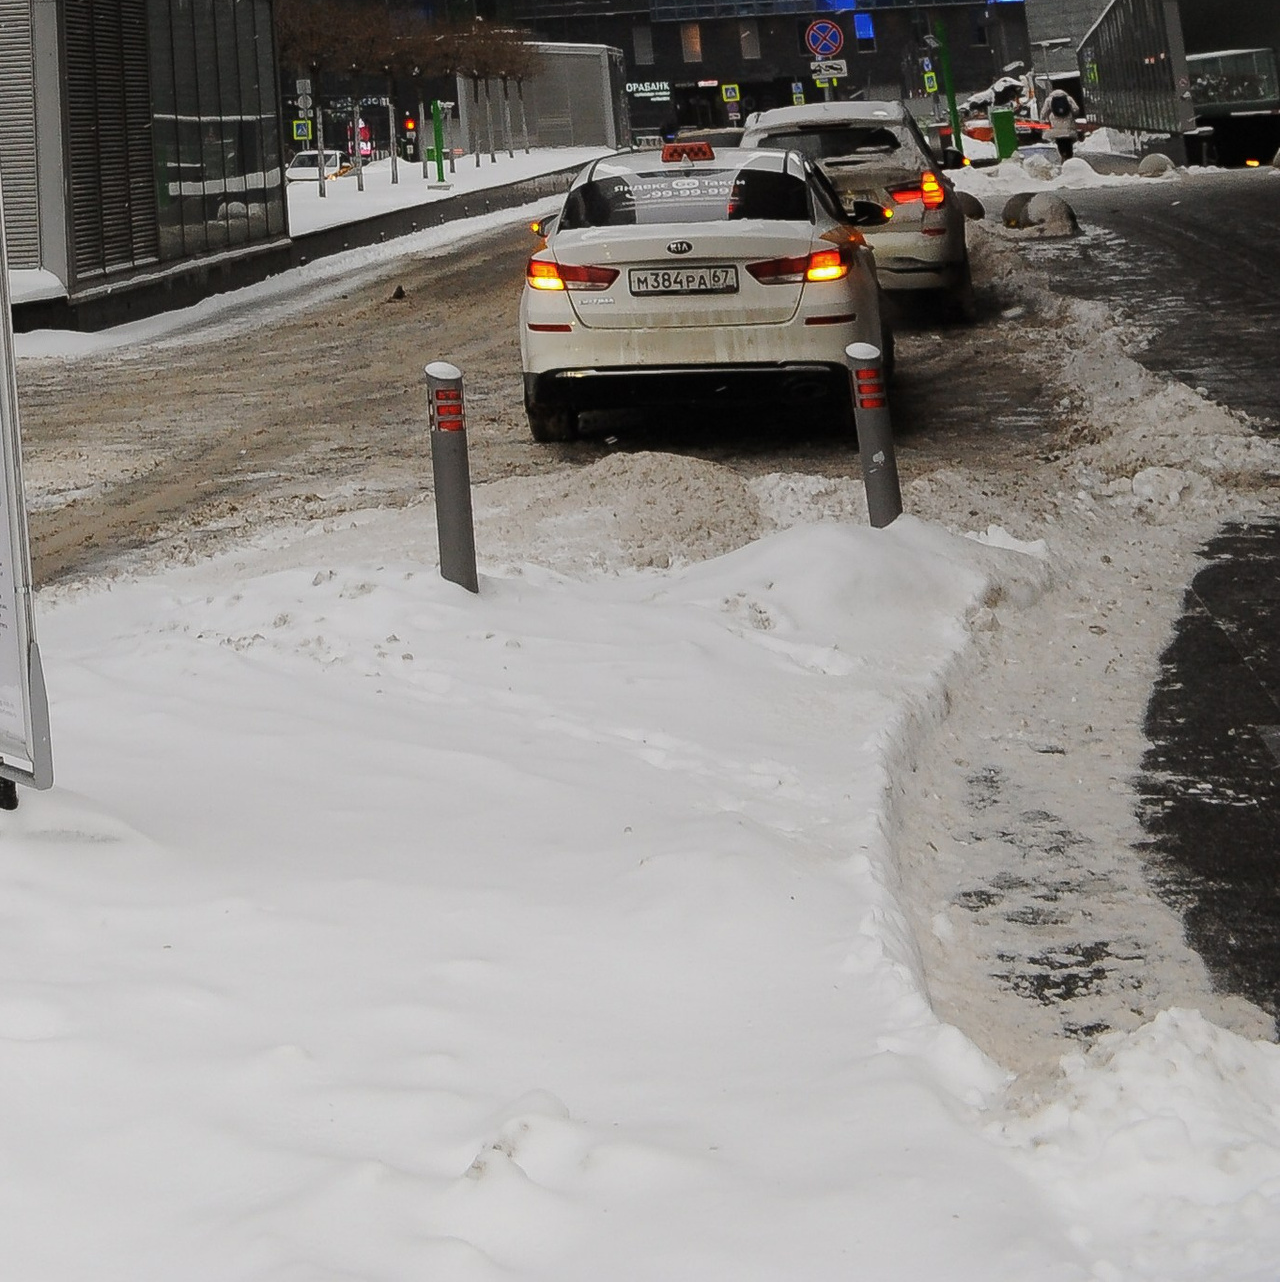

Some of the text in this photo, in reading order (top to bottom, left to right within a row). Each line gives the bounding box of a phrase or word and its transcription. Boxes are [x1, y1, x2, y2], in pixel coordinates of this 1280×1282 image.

[670, 243, 689, 251] KIA
[636, 269, 729, 290] М384РА 67
